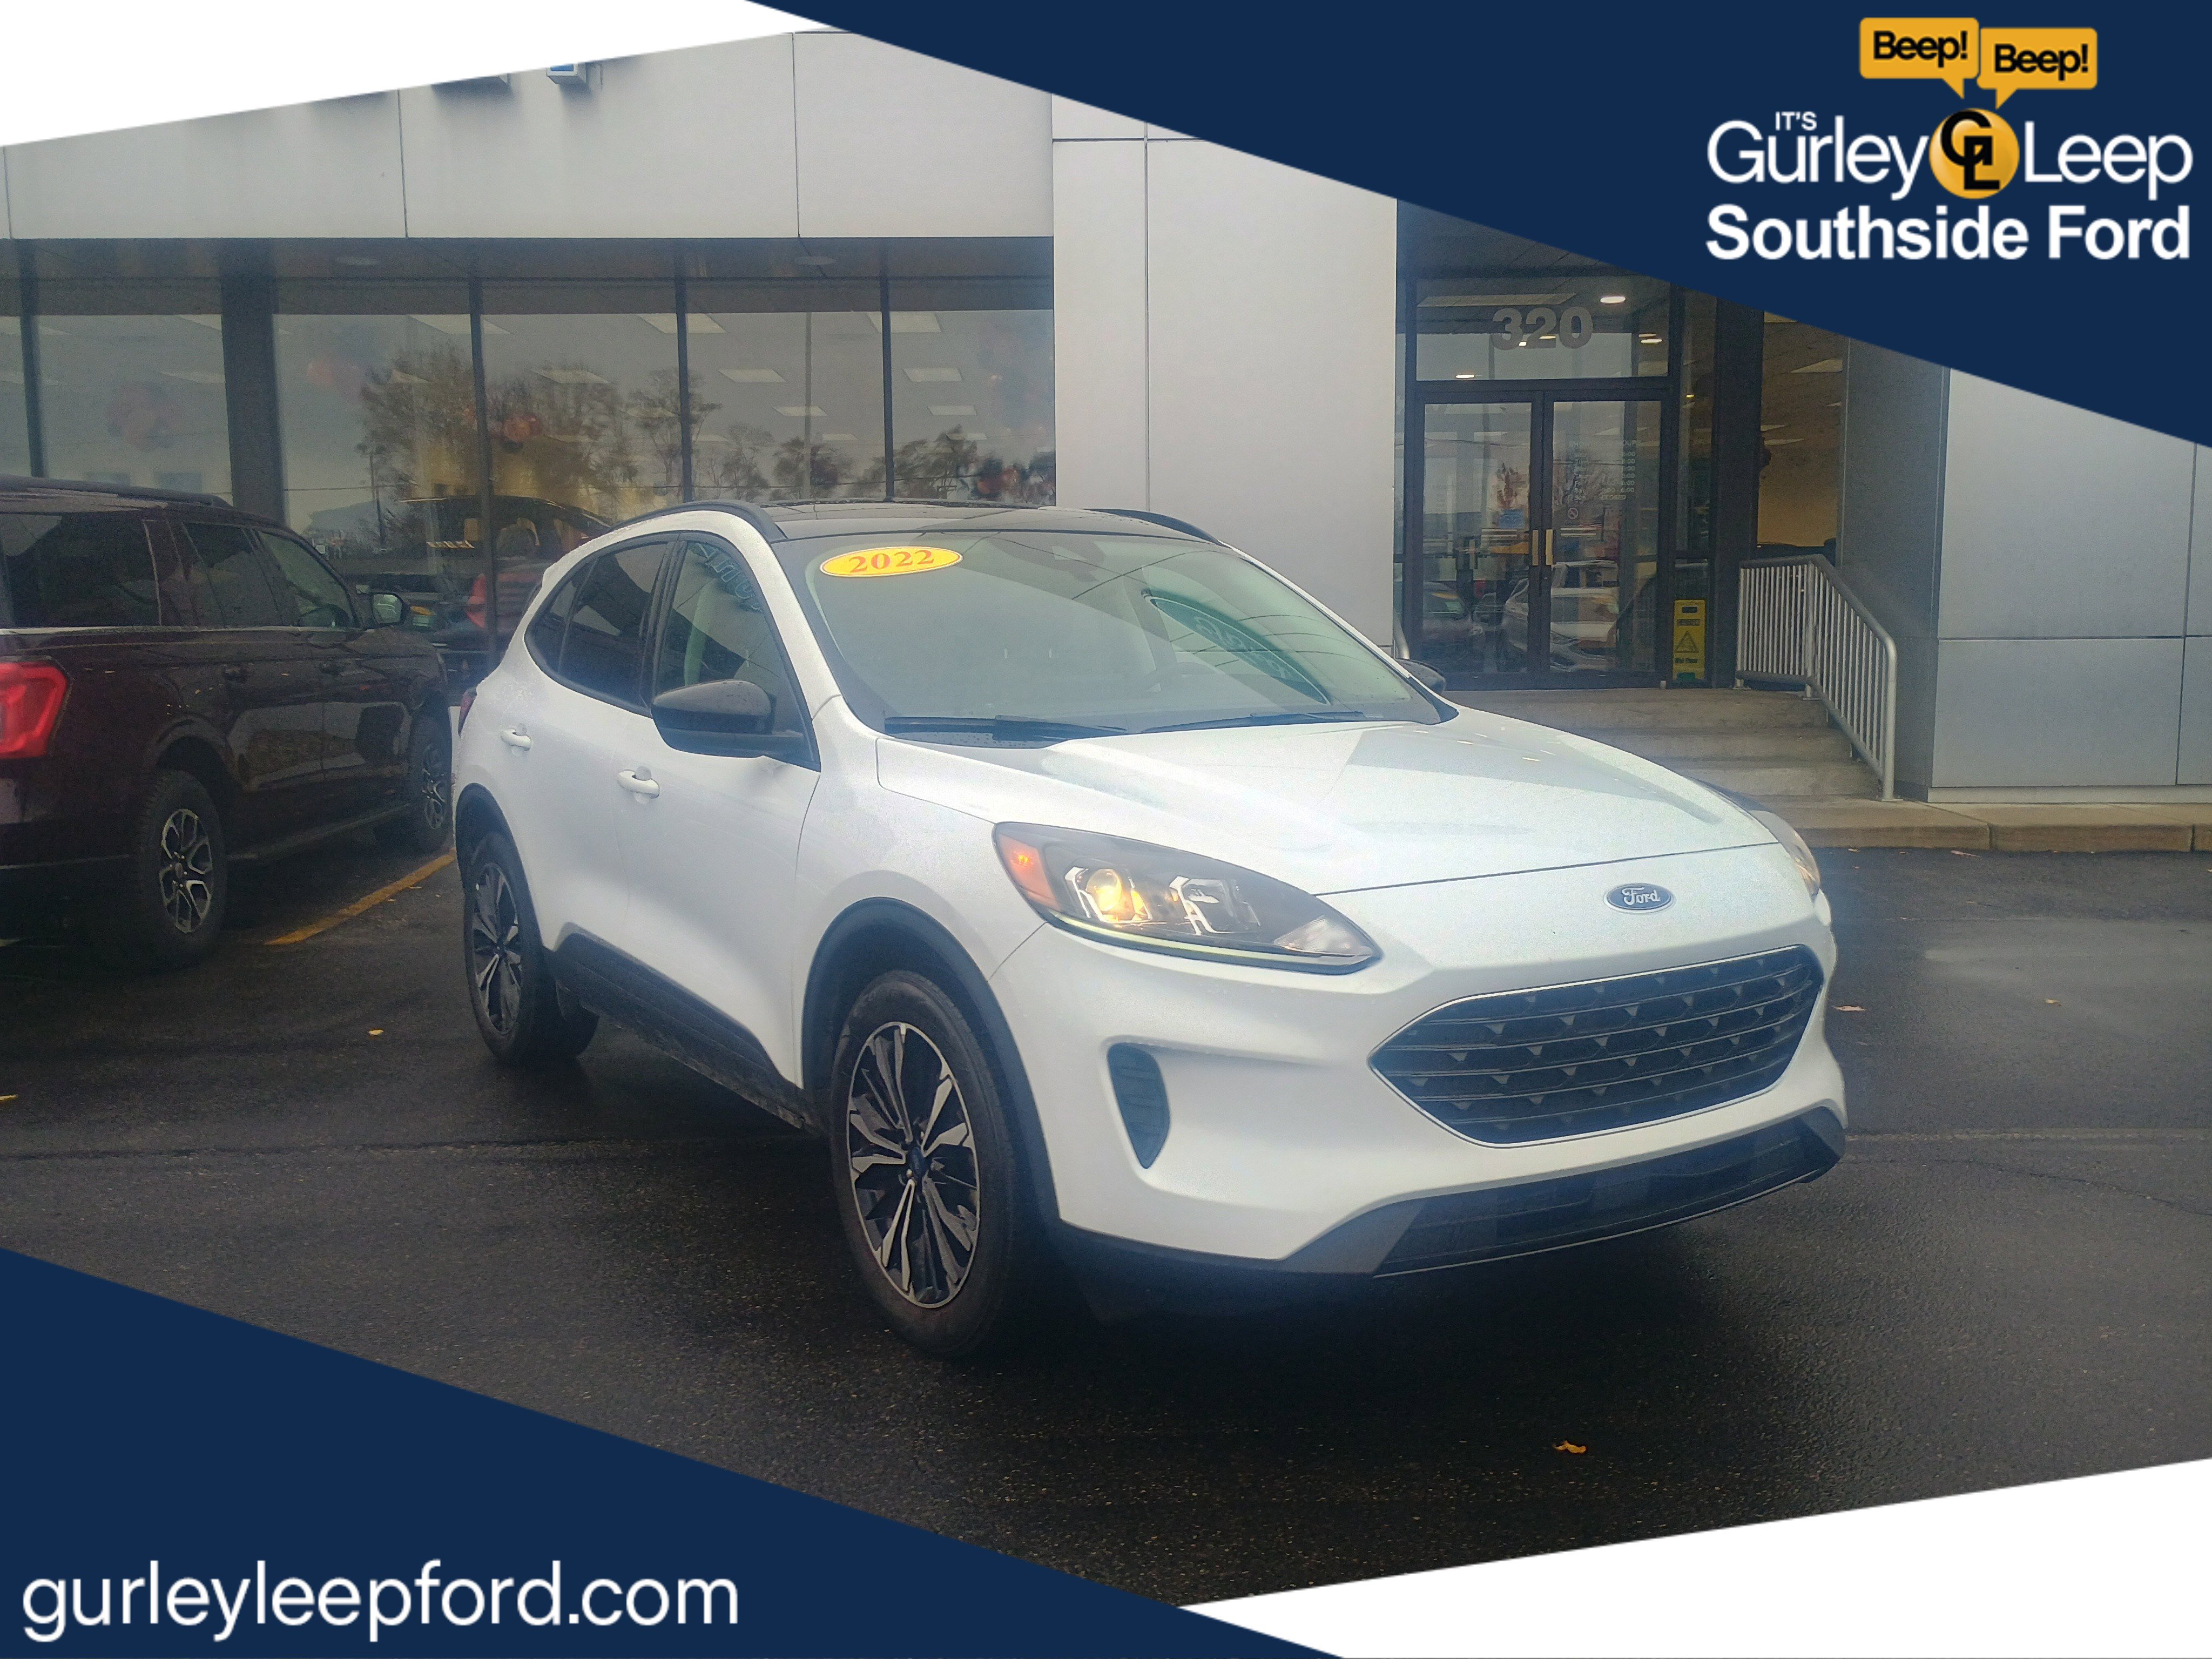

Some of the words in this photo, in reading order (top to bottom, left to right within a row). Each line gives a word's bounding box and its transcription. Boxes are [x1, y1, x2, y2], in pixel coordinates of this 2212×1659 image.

[1492, 307, 1593, 350] 320
[848, 550, 934, 573] 2022
[1622, 887, 1660, 905] Ford
